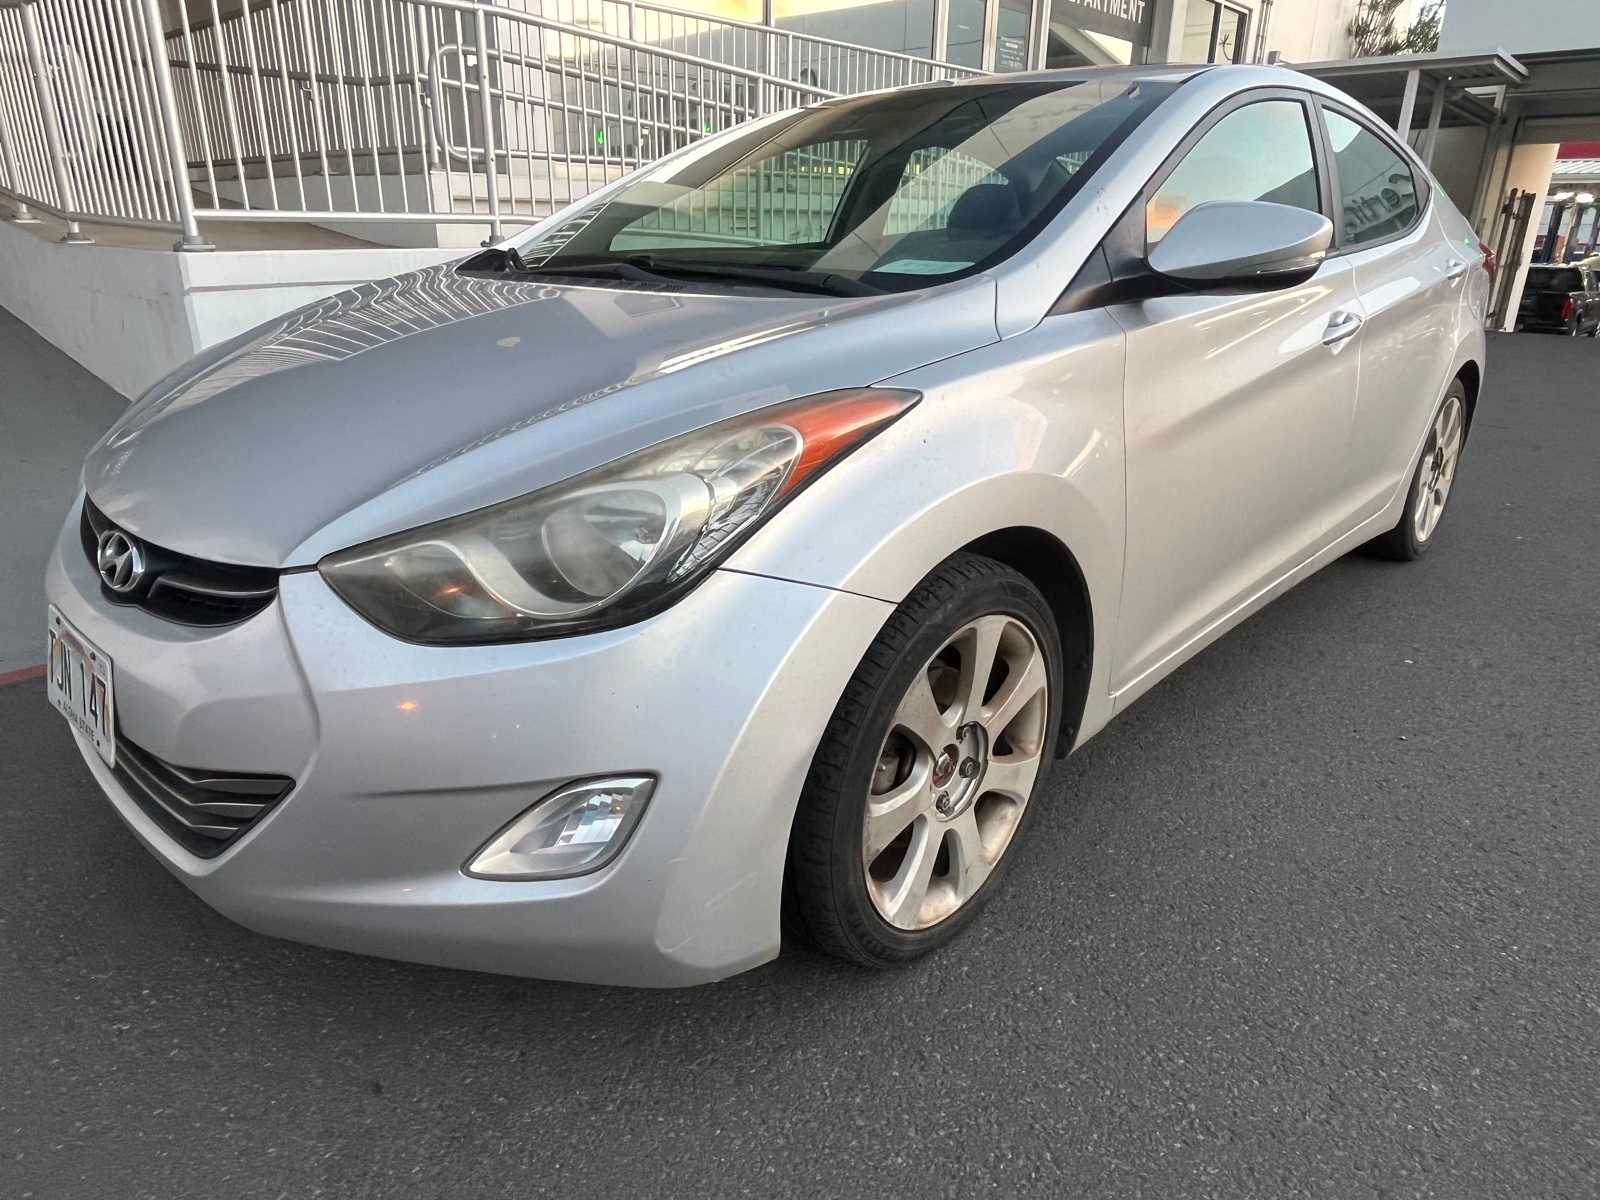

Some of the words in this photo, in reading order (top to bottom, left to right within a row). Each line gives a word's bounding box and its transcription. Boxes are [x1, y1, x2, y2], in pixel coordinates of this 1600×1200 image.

[1068, 0, 1145, 23] TMENT
[49, 628, 72, 701] TJN
[81, 661, 106, 736] 147
[79, 717, 95, 742] STATE
